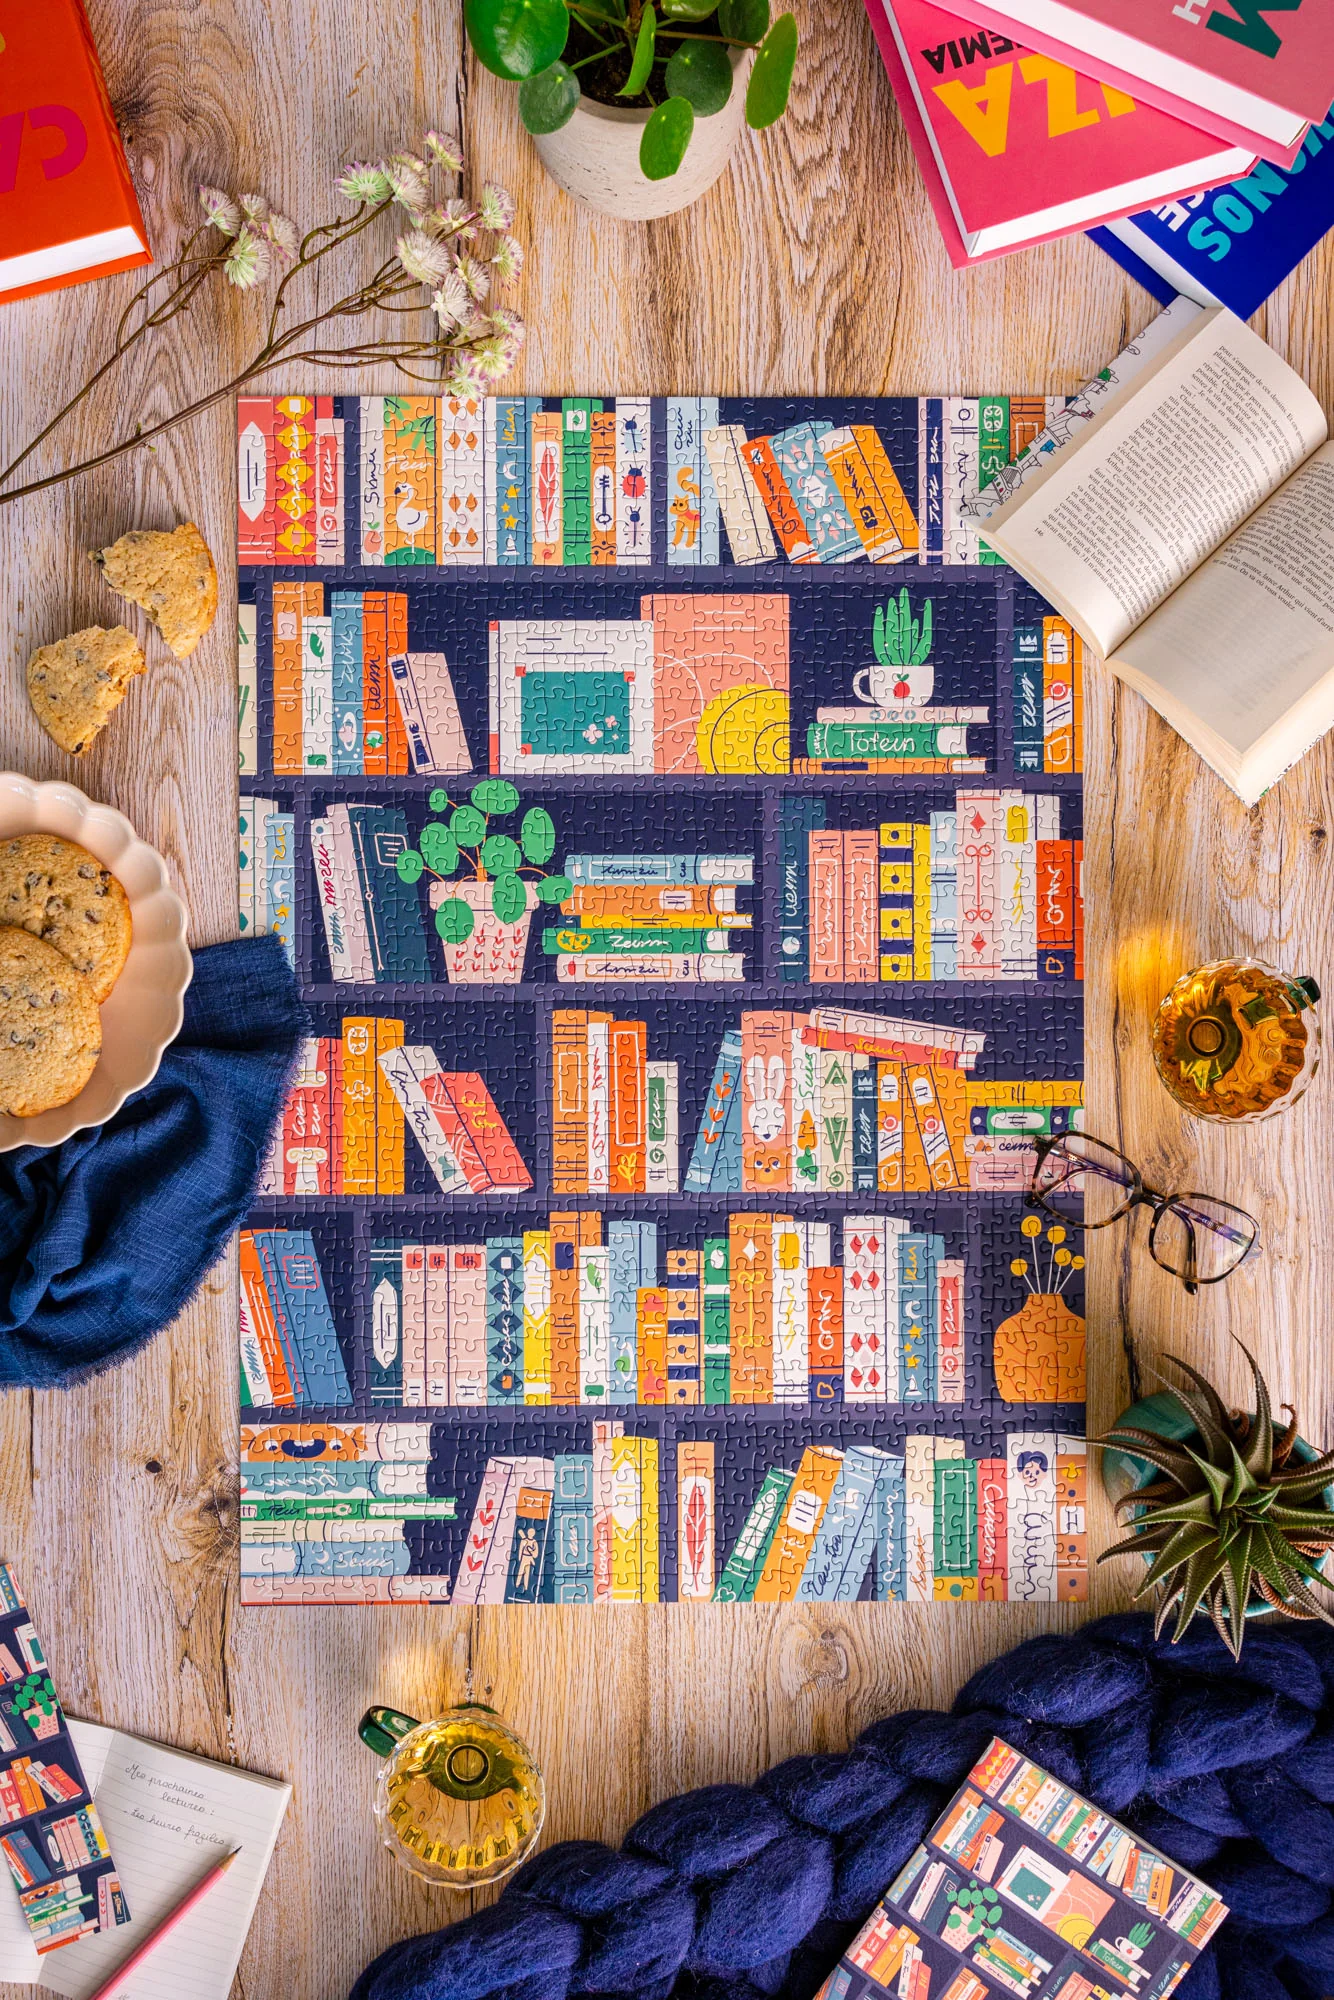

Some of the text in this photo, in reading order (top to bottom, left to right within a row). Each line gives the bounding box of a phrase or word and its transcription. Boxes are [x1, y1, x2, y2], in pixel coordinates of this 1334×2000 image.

[921, 30, 1024, 74] EMIA
[125, 1763, 205, 1799] Mes prochaines
[160, 1792, 206, 1813] lectures
